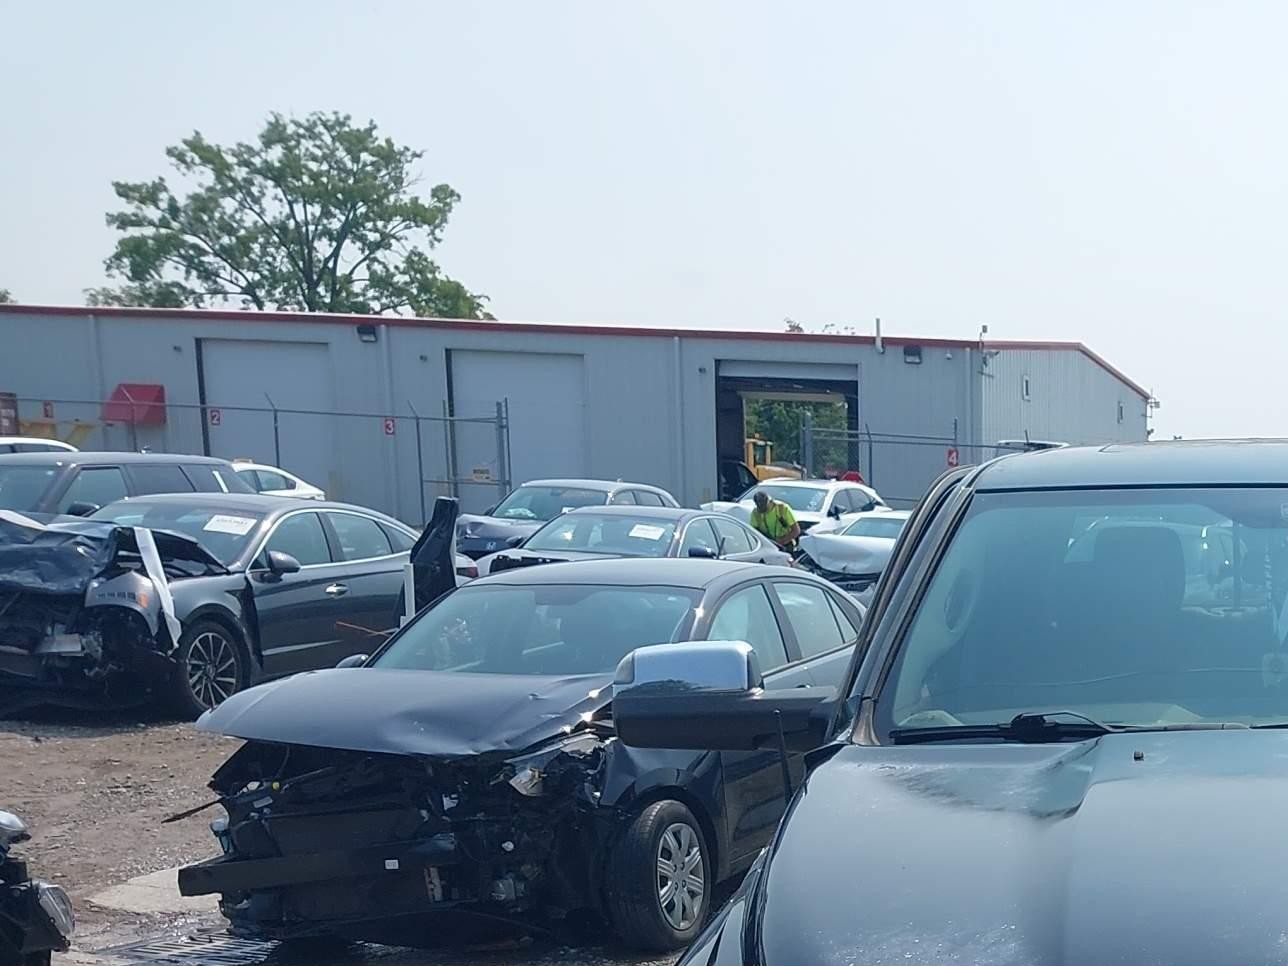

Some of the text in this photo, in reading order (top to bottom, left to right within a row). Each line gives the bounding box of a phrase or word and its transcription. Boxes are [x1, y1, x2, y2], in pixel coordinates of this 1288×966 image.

[210, 411, 220, 424] 2
[386, 420, 394, 434] 3
[948, 449, 957, 465] 4
